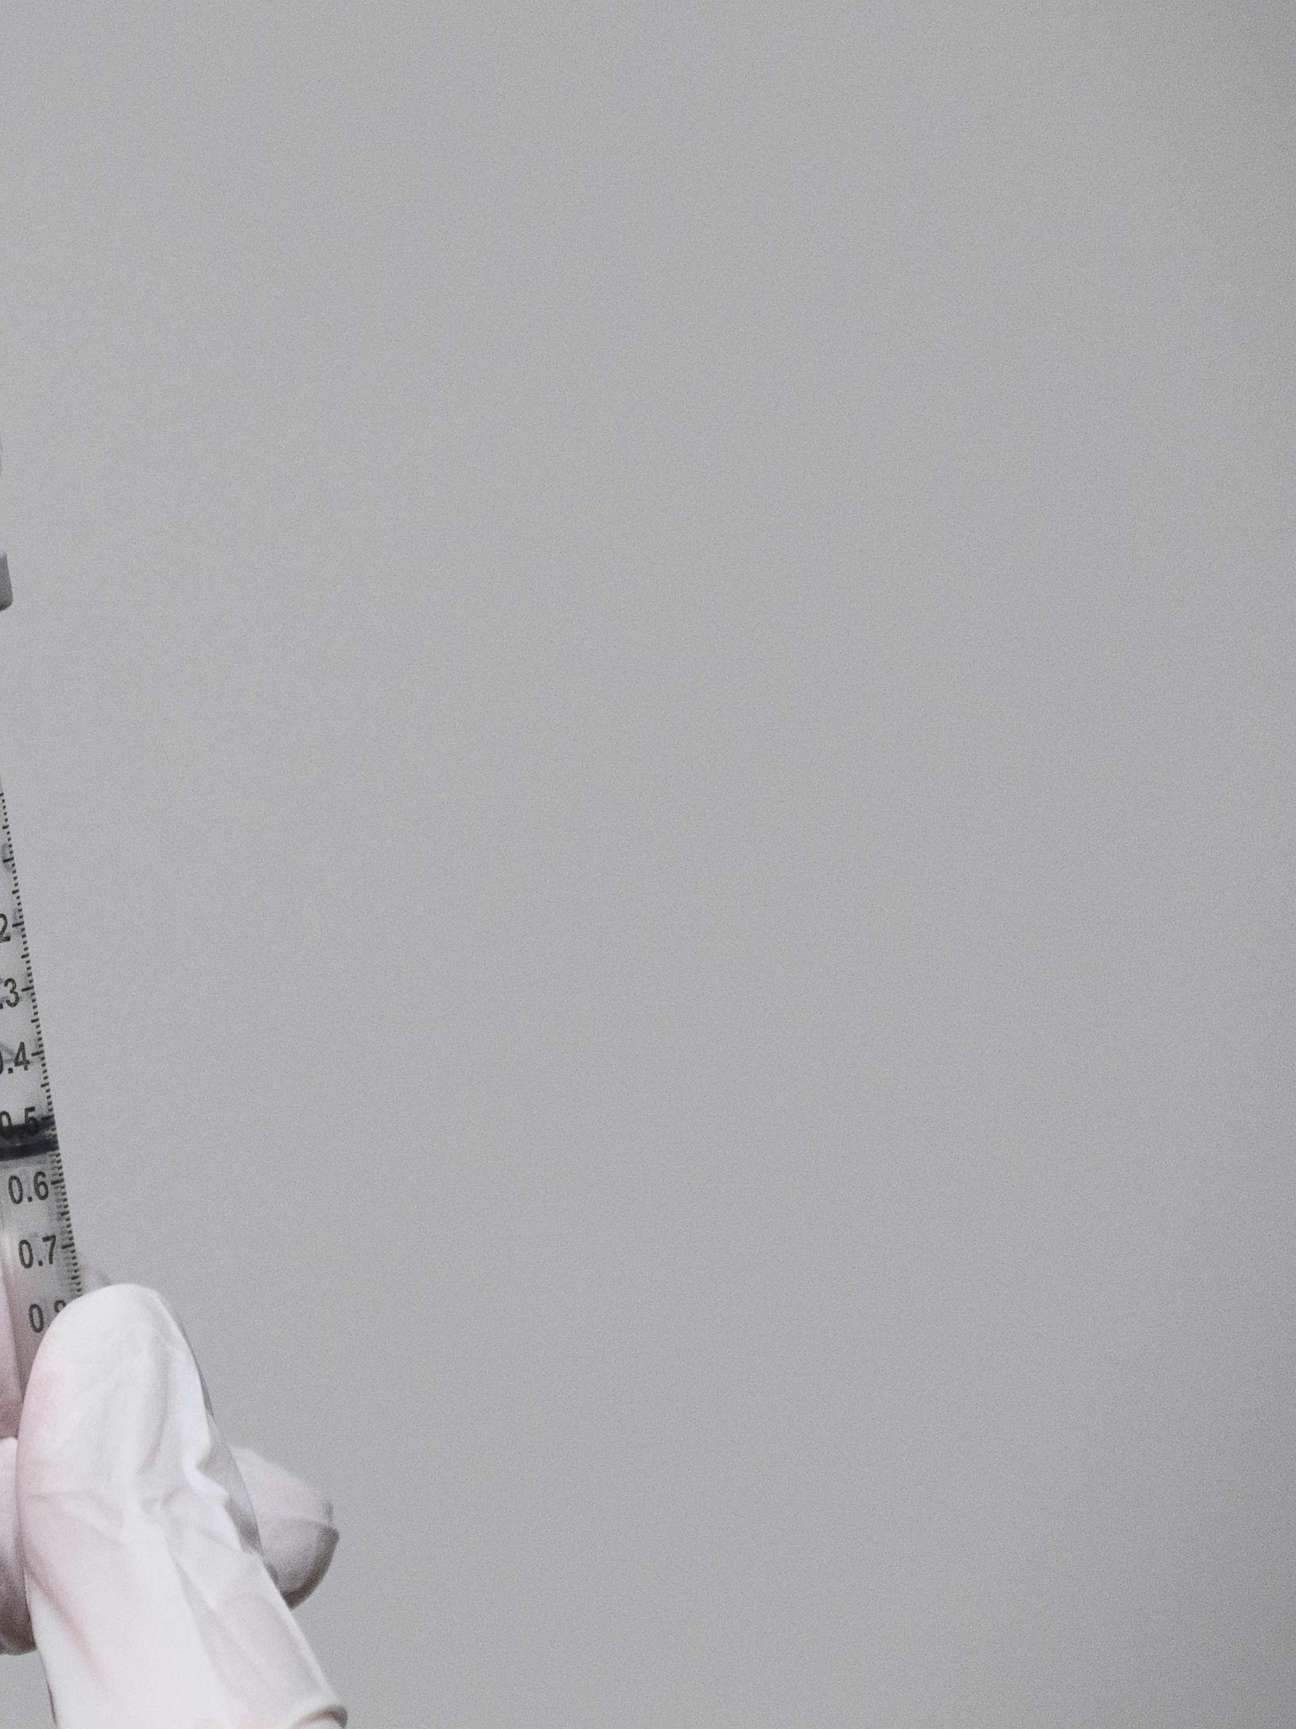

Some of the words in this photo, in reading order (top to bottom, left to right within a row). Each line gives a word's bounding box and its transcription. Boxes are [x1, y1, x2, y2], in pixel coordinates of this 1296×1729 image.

[0, 1107, 39, 1139] 05
[8, 1171, 49, 1204] 0.6
[18, 1236, 56, 1268] 0.7
